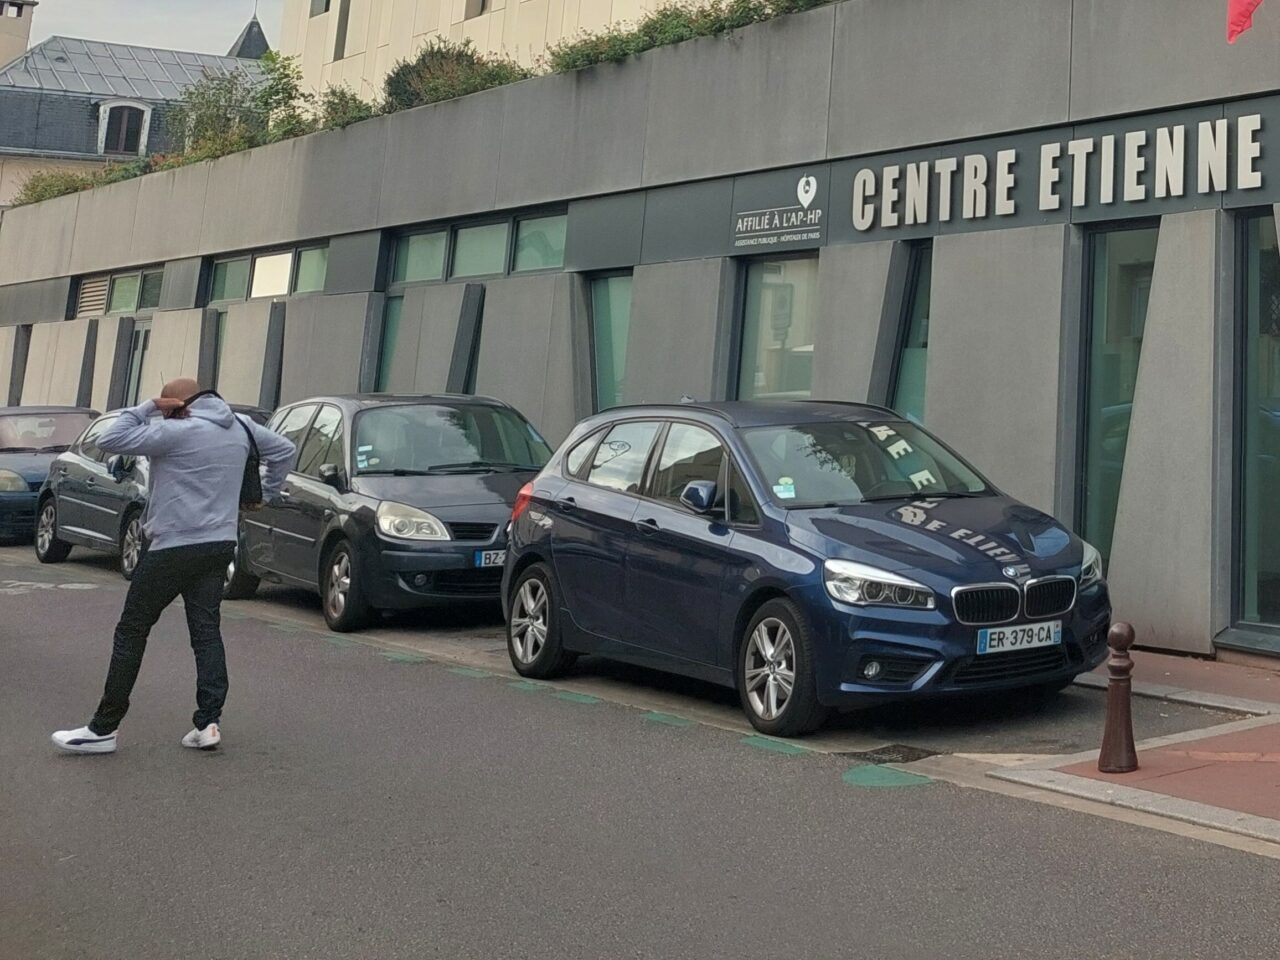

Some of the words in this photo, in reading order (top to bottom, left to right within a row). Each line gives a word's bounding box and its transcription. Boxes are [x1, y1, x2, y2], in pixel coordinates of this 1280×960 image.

[852, 149, 1017, 231] CENTRE
[1038, 114, 1262, 210] ETIENNE
[735, 212, 770, 232] AFFILIÉ
[772, 211, 780, 228] À
[782, 209, 822, 227] L'AP-HP
[988, 625, 1052, 649] ER-379-CA
